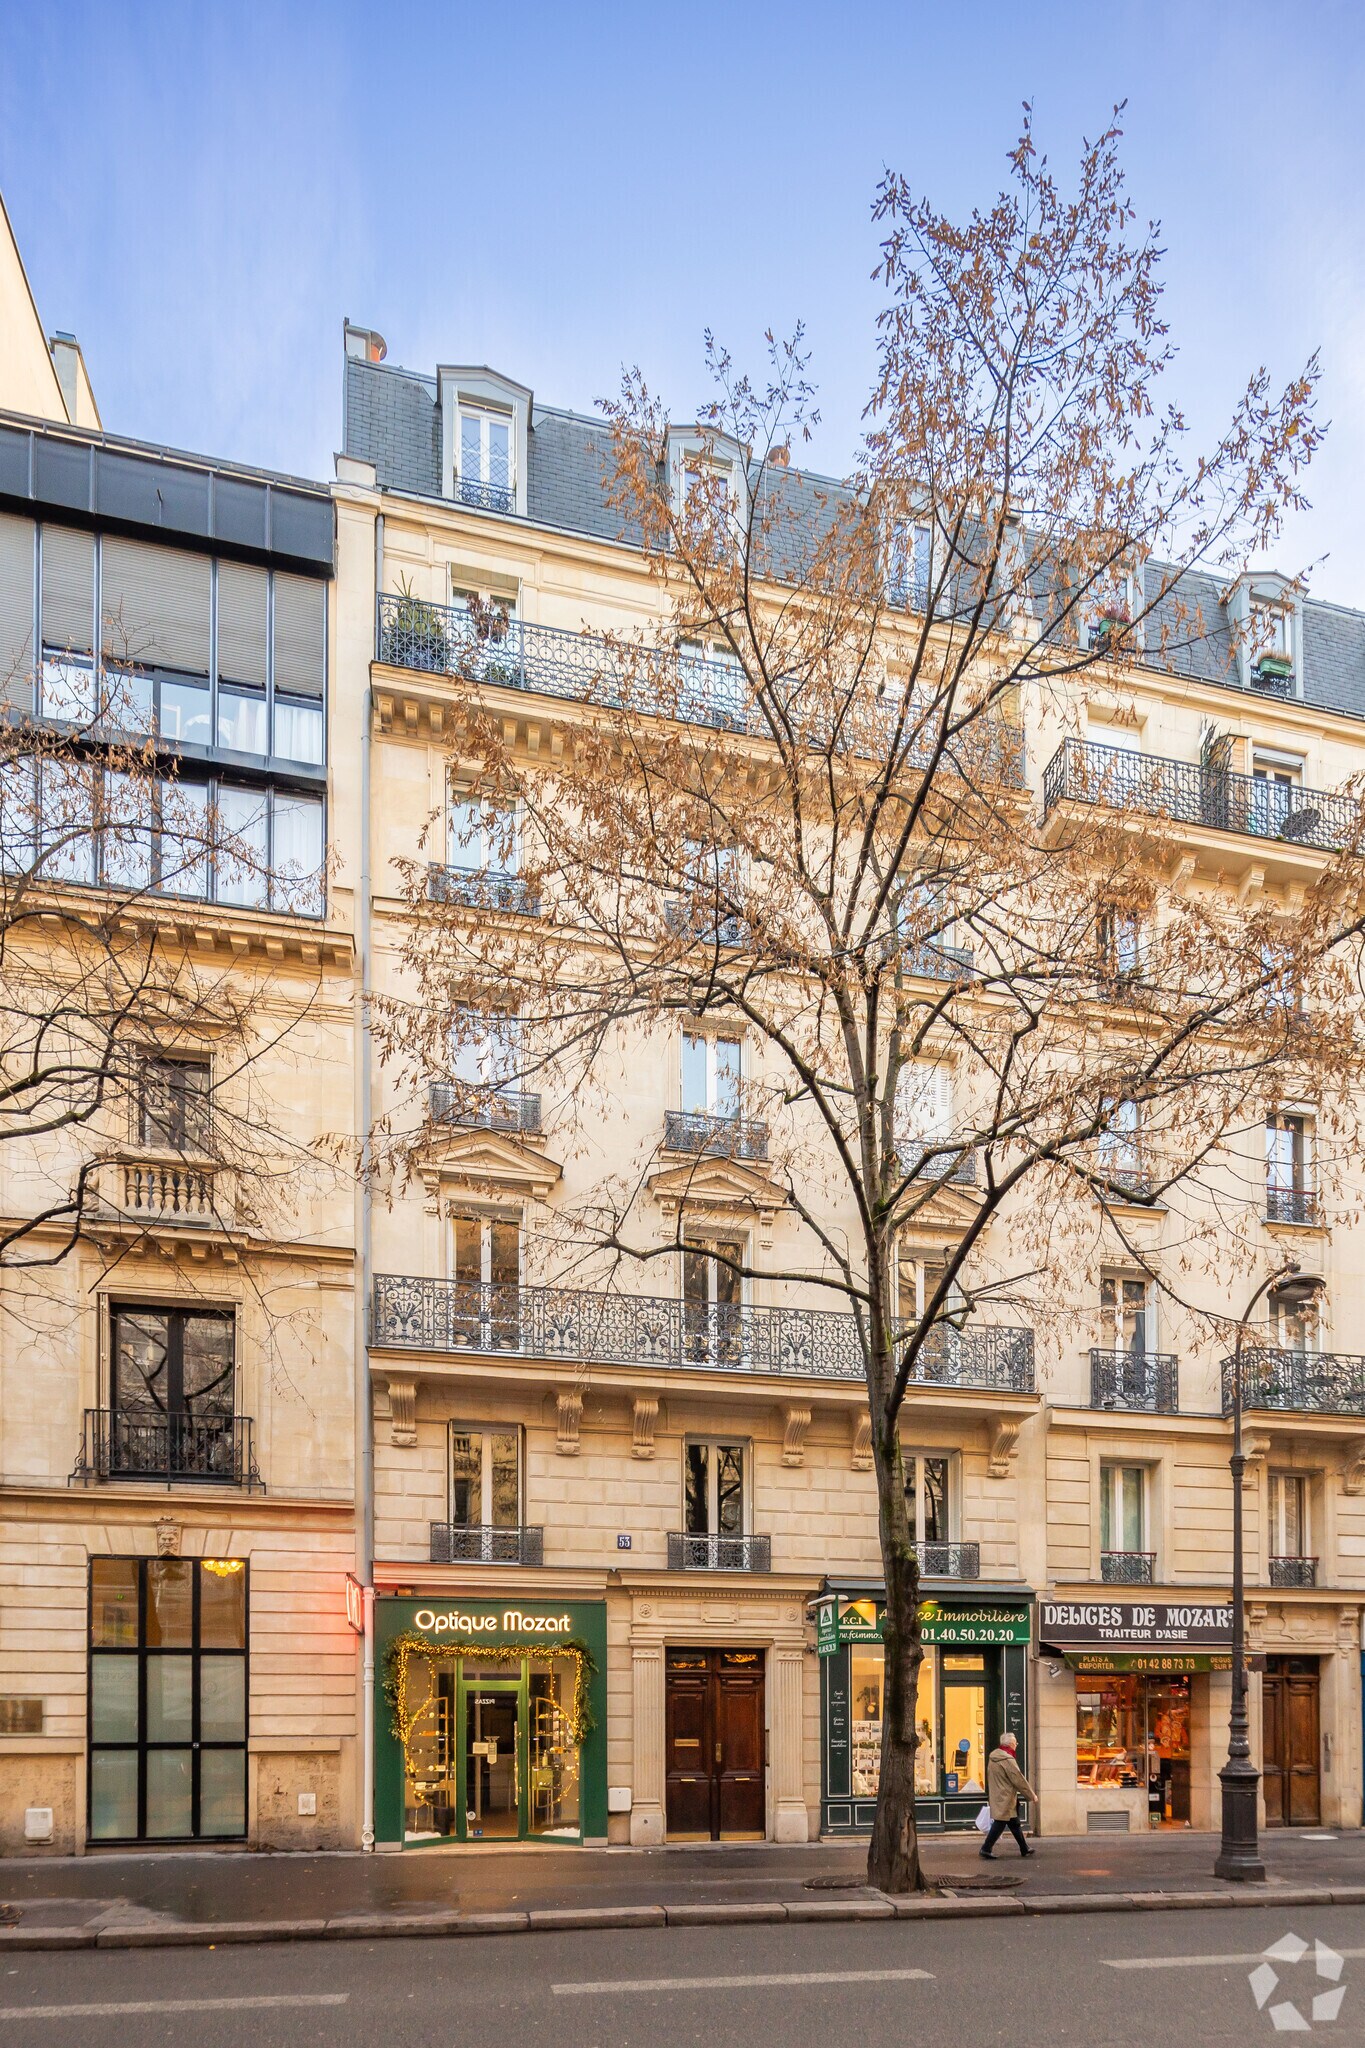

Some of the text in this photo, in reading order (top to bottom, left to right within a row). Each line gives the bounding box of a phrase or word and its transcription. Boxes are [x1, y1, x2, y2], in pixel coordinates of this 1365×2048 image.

[618, 1536, 630, 1548] 53
[415, 1610, 570, 1634] Optique Mozart
[936, 1609, 1028, 1622] Immobilière
[1044, 1605, 1122, 1626] DELICES
[1132, 1607, 1156, 1627] DE
[920, 1628, 1014, 1641] 01.40.50.20.20
[1099, 1628, 1188, 1640] TRAITEUR D'ASIE
[1138, 1658, 1195, 1669] 01 42 88 73 73
